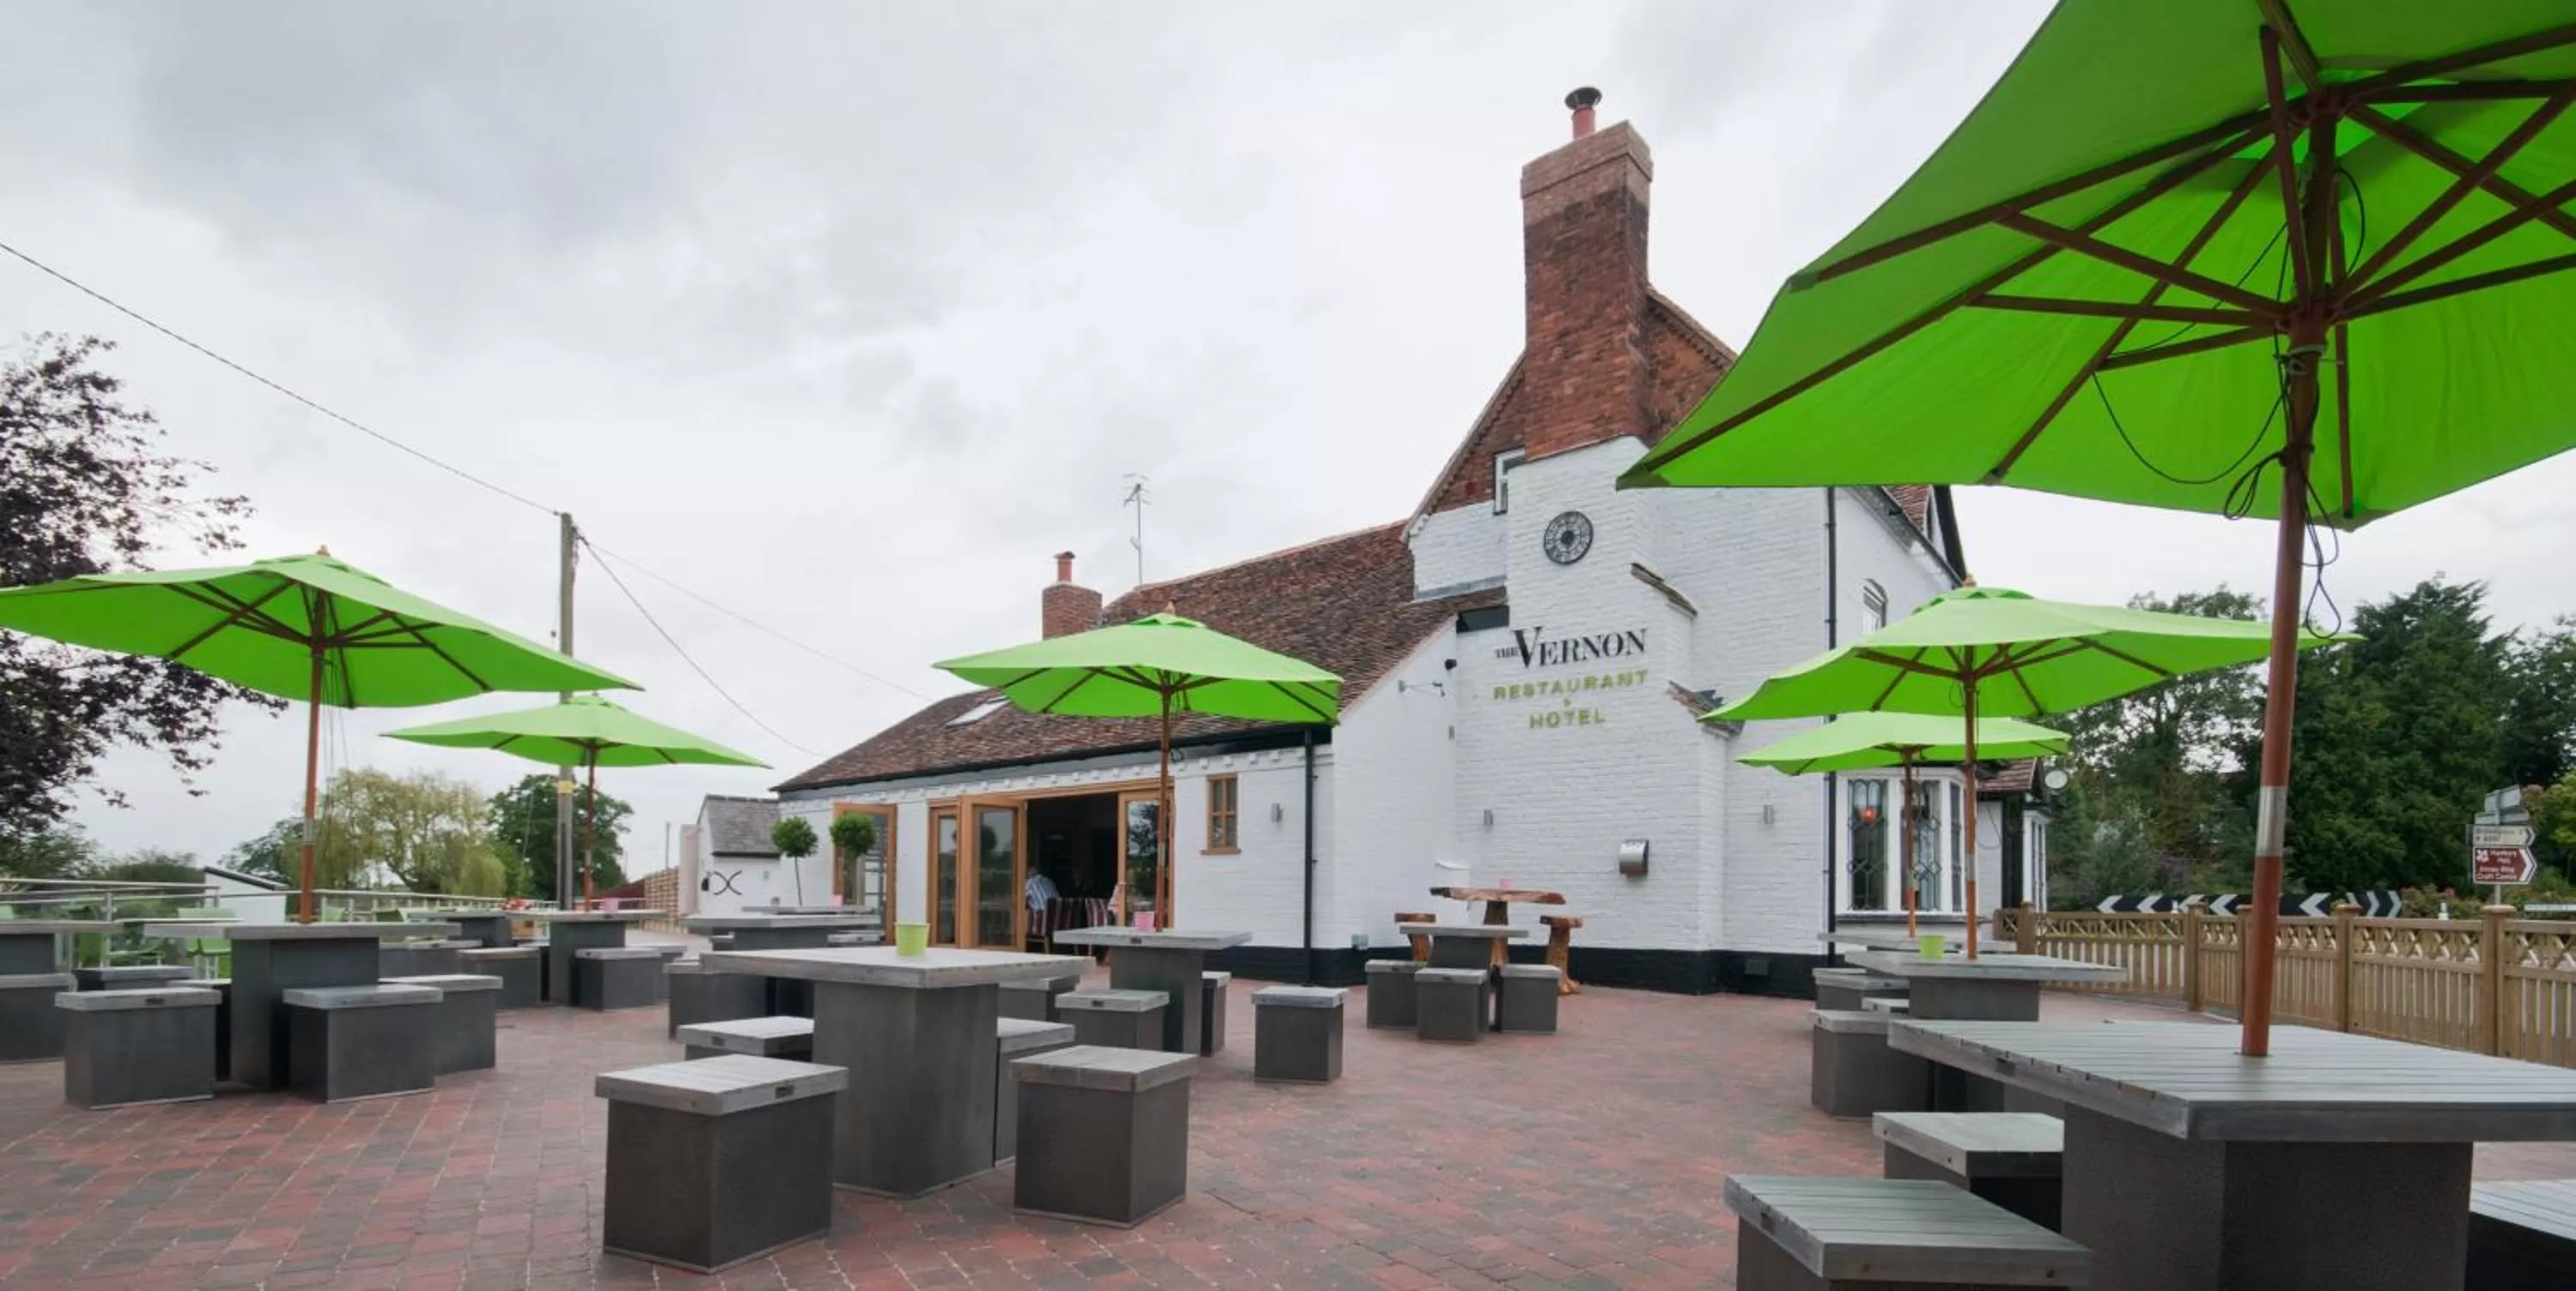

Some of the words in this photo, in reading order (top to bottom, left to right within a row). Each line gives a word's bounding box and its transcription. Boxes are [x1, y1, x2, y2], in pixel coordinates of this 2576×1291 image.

[1495, 646, 1518, 658] THE
[1512, 626, 1648, 669] VERNON
[1493, 670, 1648, 700] RESTAURANT
[1529, 706, 1605, 729] HOTEL
